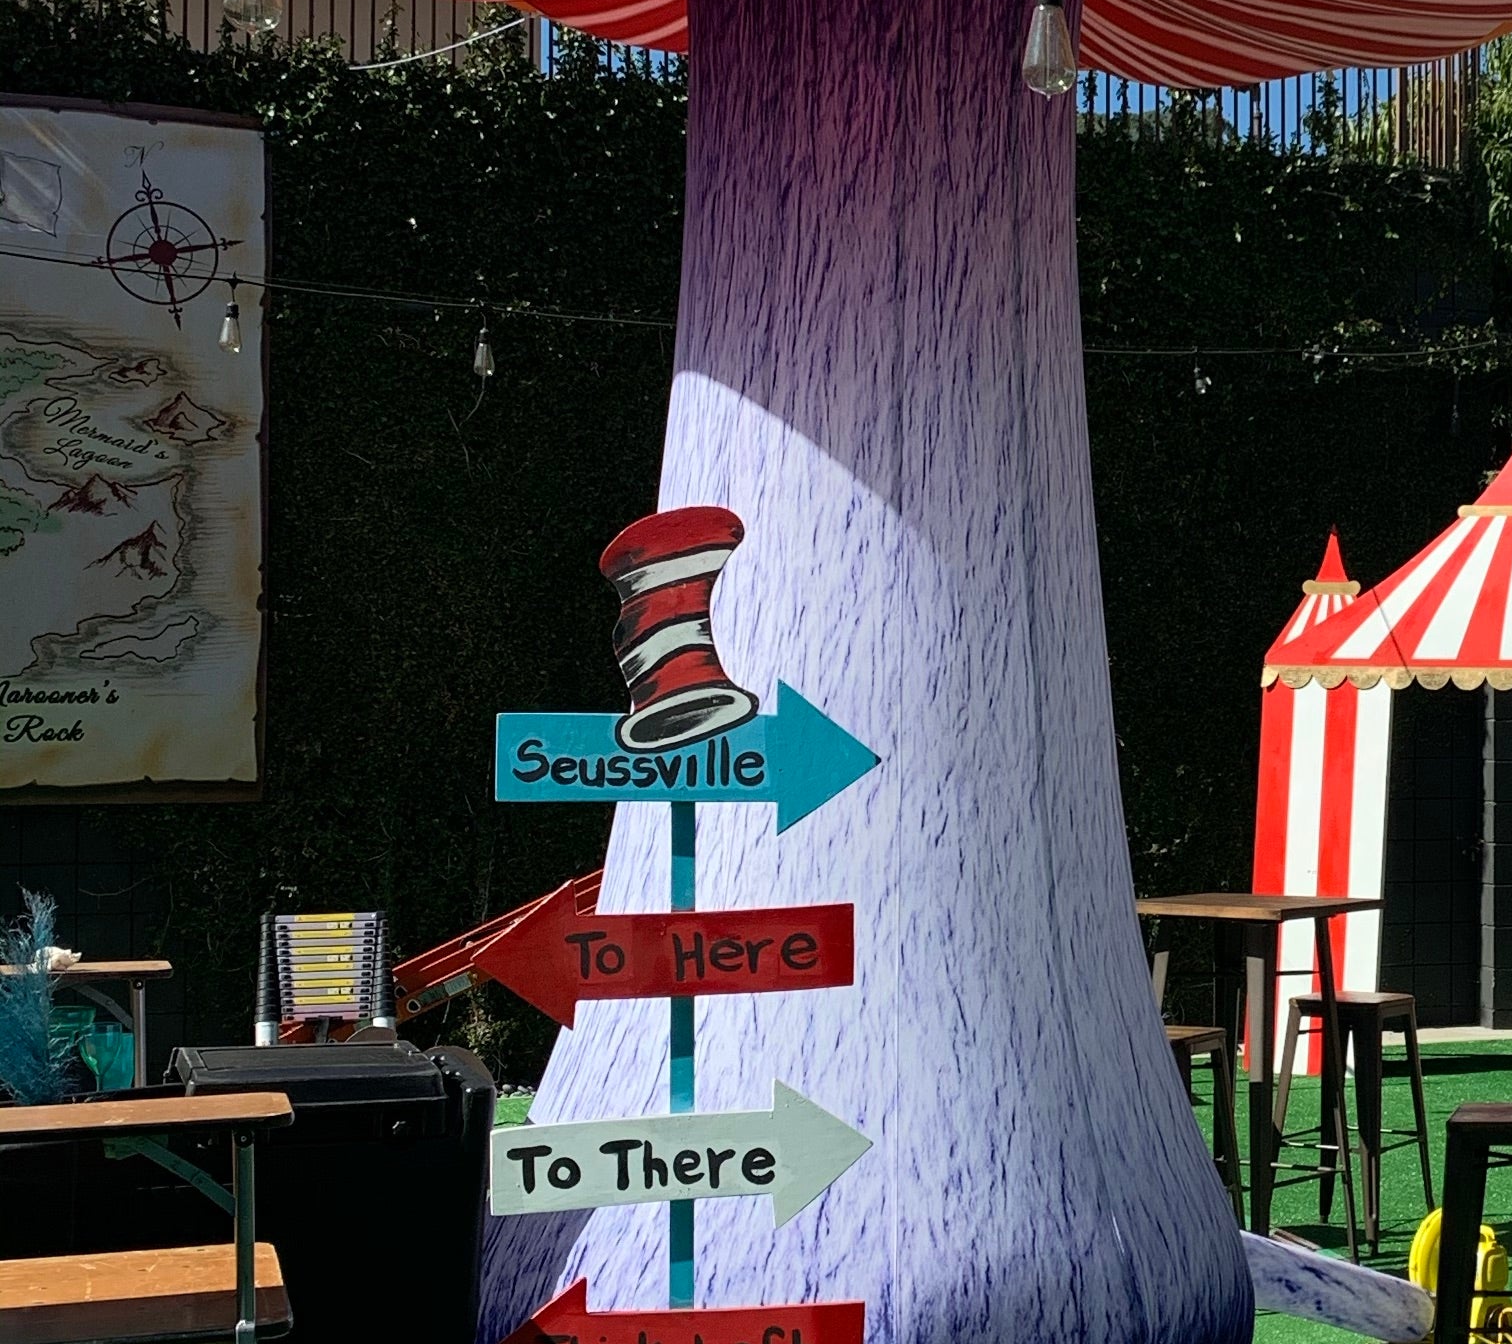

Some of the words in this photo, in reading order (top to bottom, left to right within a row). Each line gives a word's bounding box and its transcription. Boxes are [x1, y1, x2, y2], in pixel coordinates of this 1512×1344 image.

[44, 397, 169, 459] Mermaid's
[43, 438, 133, 470] Lagoon
[4, 715, 84, 742] Rock
[511, 738, 765, 788] Seussville
[565, 930, 625, 980] To
[672, 931, 819, 981] Here
[506, 1145, 581, 1194] To
[600, 1139, 776, 1190] There
